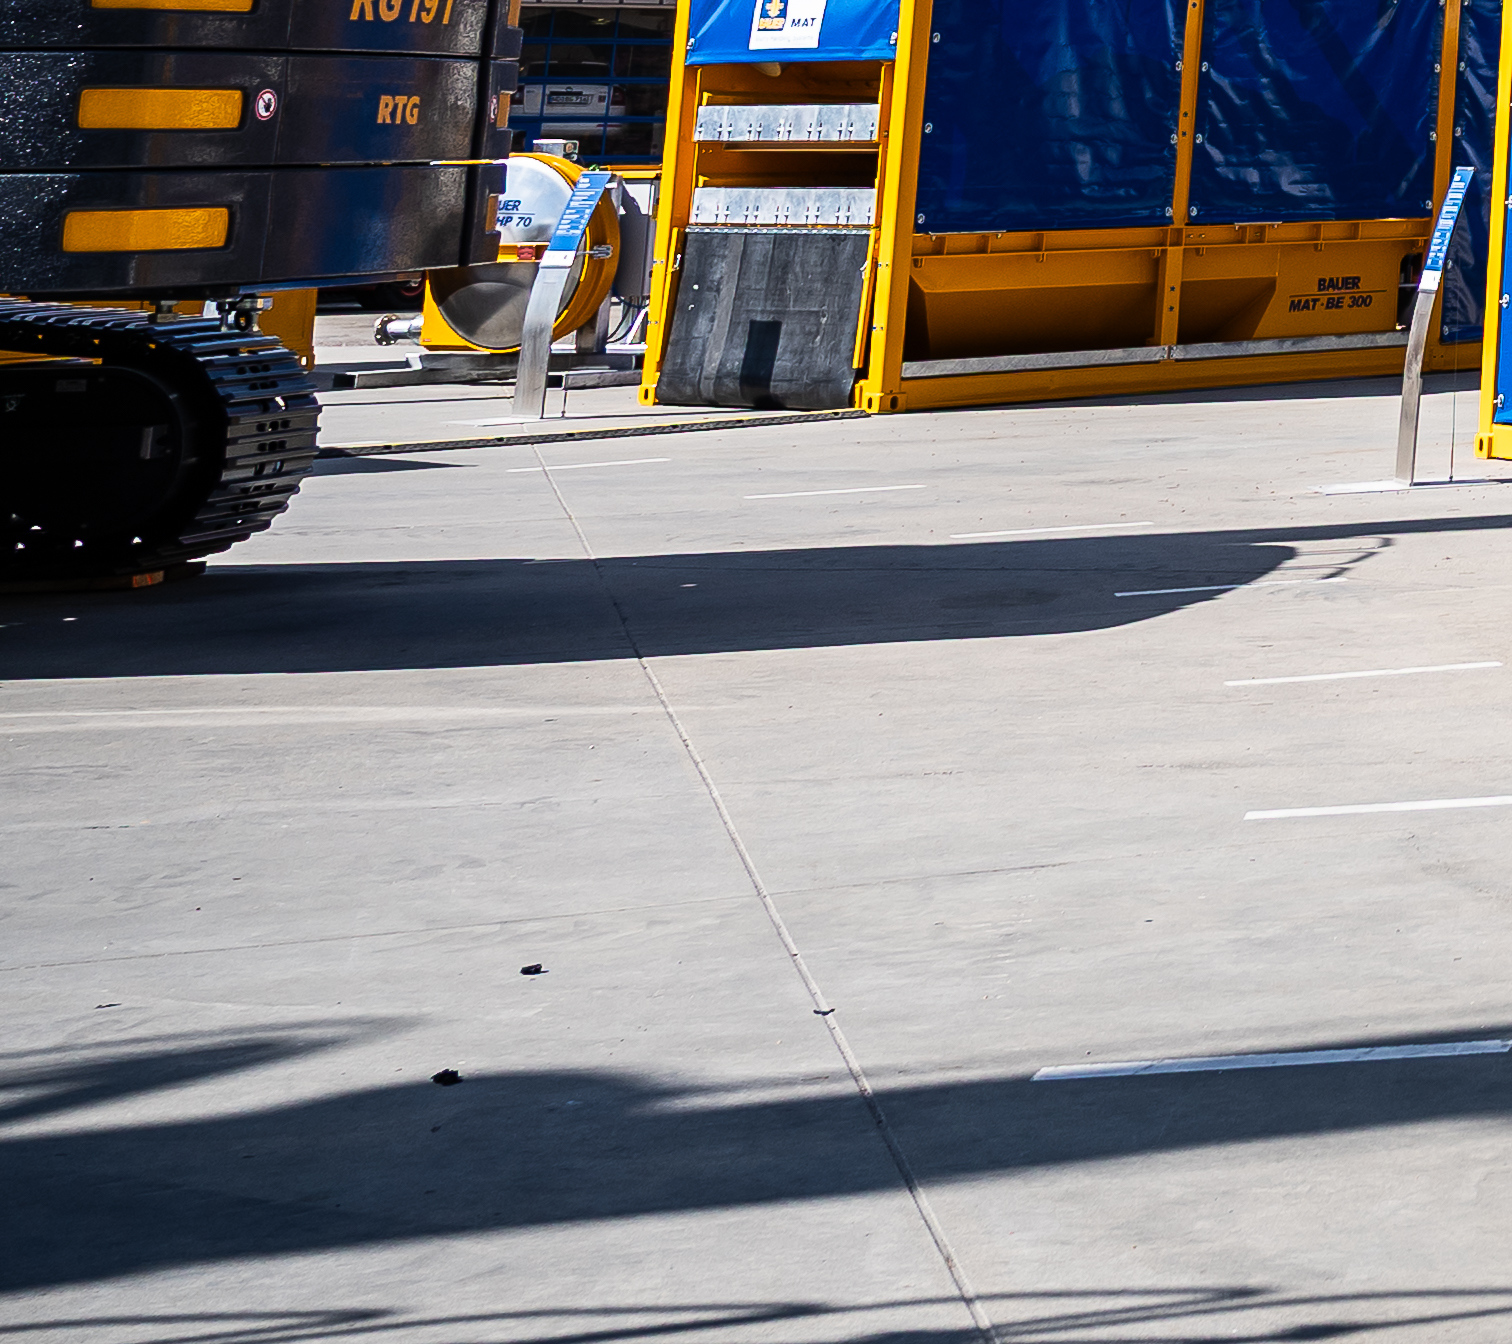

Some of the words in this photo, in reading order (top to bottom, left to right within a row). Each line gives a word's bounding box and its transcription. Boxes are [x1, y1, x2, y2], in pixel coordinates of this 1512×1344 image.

[791, 18, 816, 27] MAT
[377, 95, 420, 124] RTG
[516, 216, 532, 227] 70
[1318, 276, 1361, 291] BAUER
[1348, 295, 1372, 308] 300
